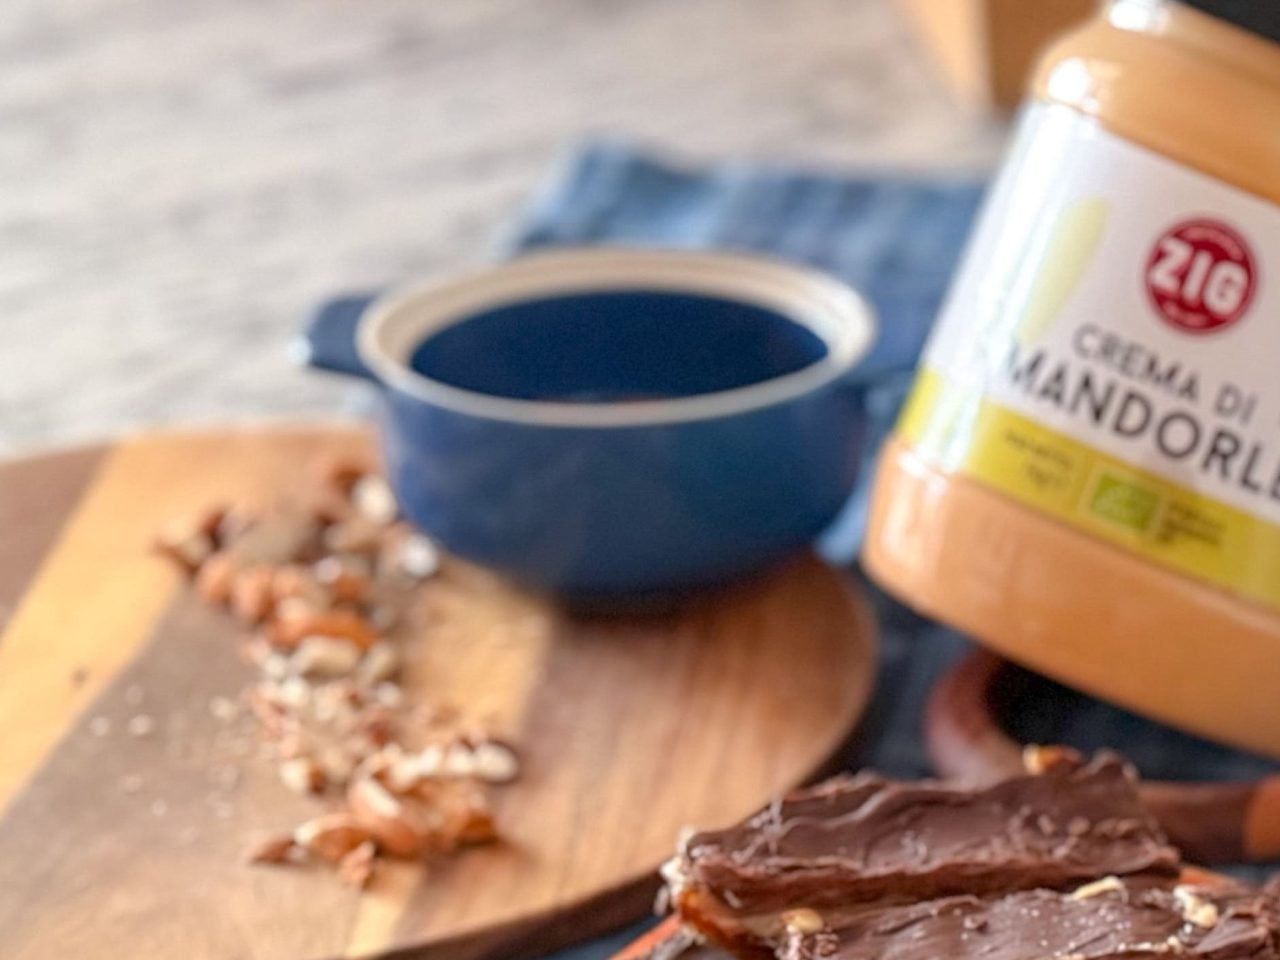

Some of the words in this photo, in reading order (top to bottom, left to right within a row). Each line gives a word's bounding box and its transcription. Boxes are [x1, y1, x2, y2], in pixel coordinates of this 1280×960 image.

[1151, 237, 1250, 317] ZIG
[1070, 322, 1201, 402] CREMA
[1213, 382, 1259, 425] DI
